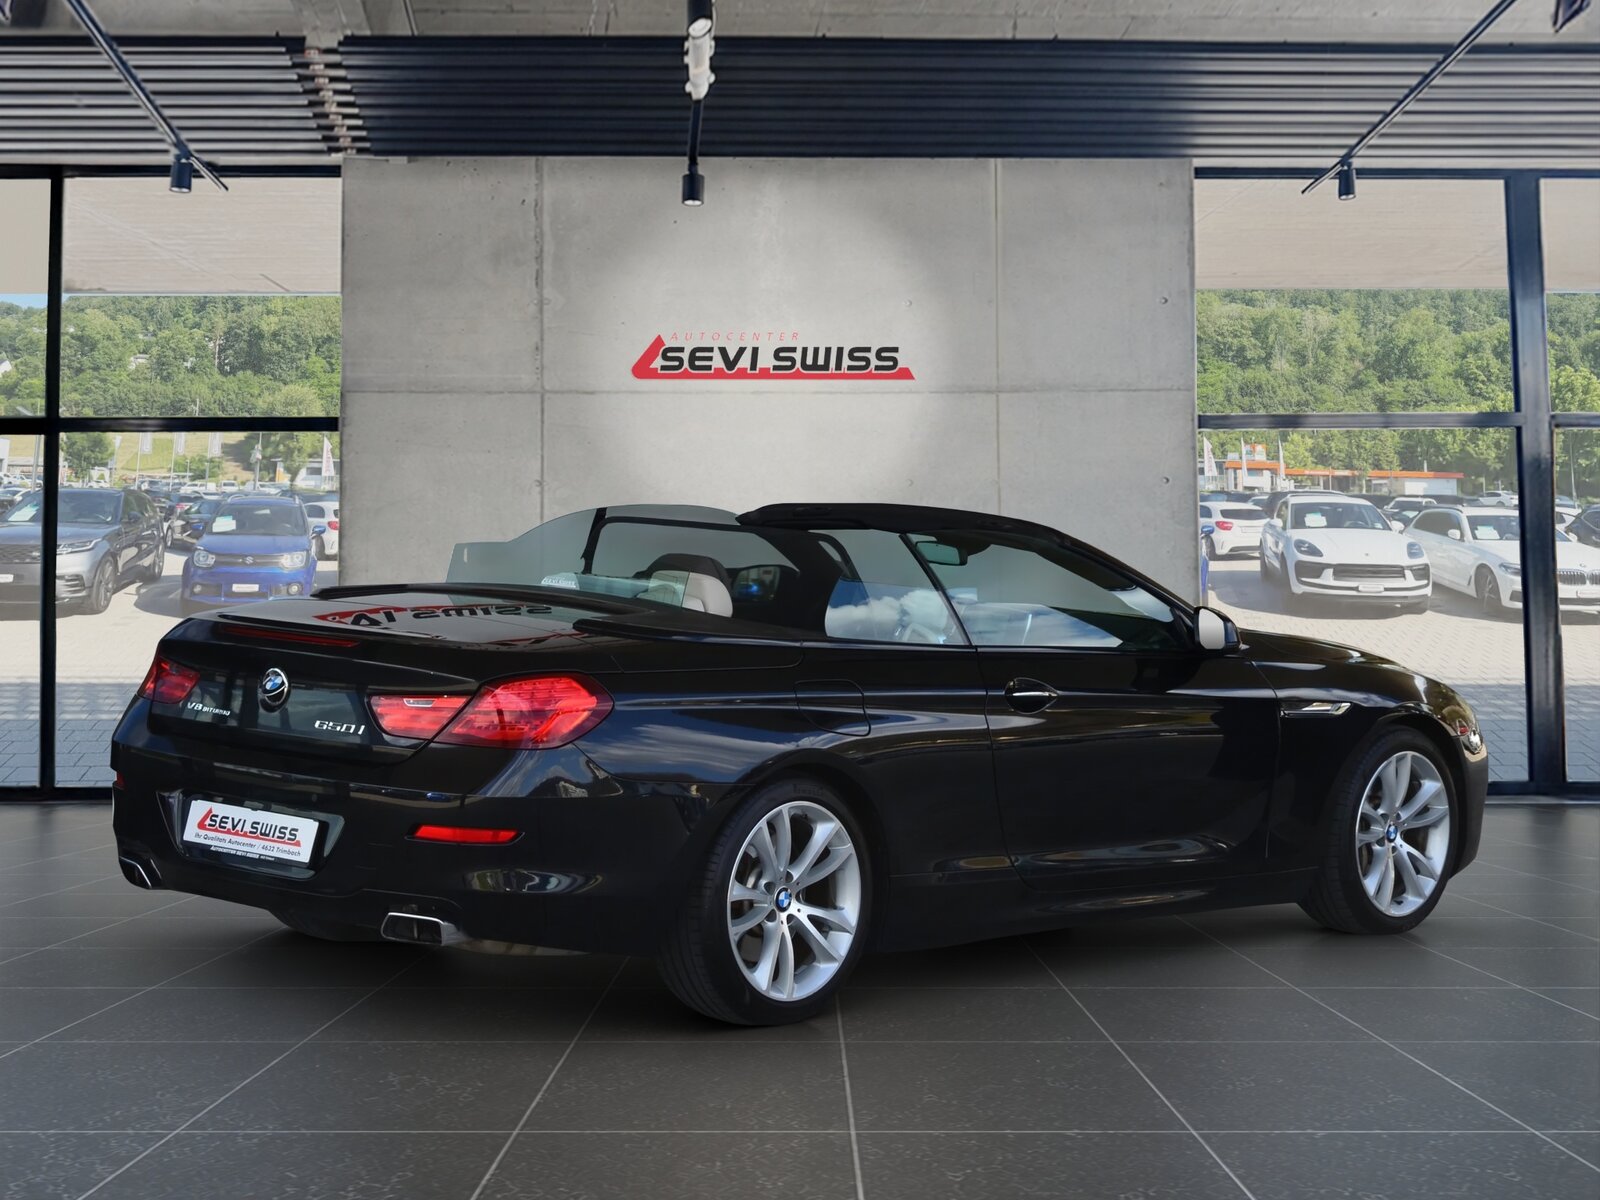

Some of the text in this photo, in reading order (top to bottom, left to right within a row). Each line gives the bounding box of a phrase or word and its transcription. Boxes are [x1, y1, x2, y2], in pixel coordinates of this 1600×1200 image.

[669, 331, 800, 342] AUTOCENTER
[659, 346, 900, 372] SEVI SWISS
[187, 702, 203, 711] V8
[207, 813, 299, 841] SEVI SWISS
[228, 838, 256, 849] Autocenter
[276, 846, 301, 857] Trimbach
